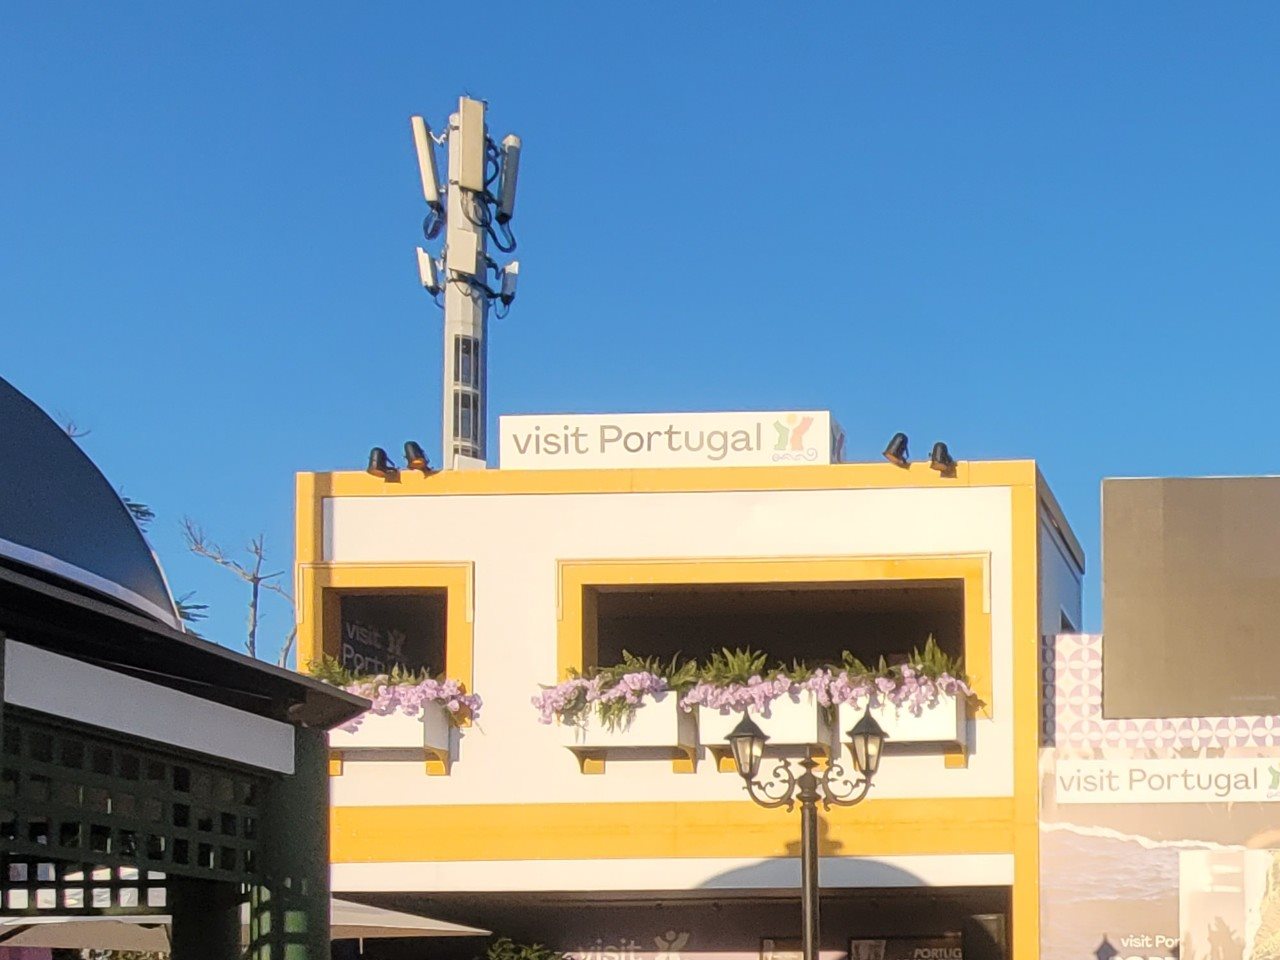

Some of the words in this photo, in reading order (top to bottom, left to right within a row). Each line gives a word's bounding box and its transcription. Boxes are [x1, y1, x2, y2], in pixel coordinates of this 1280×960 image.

[512, 425, 589, 455] visit
[600, 422, 762, 461] Portugal
[1059, 768, 1120, 793] visit
[1129, 767, 1258, 797] Portugal
[1121, 934, 1152, 948] visit
[914, 948, 962, 959] PORTUG
